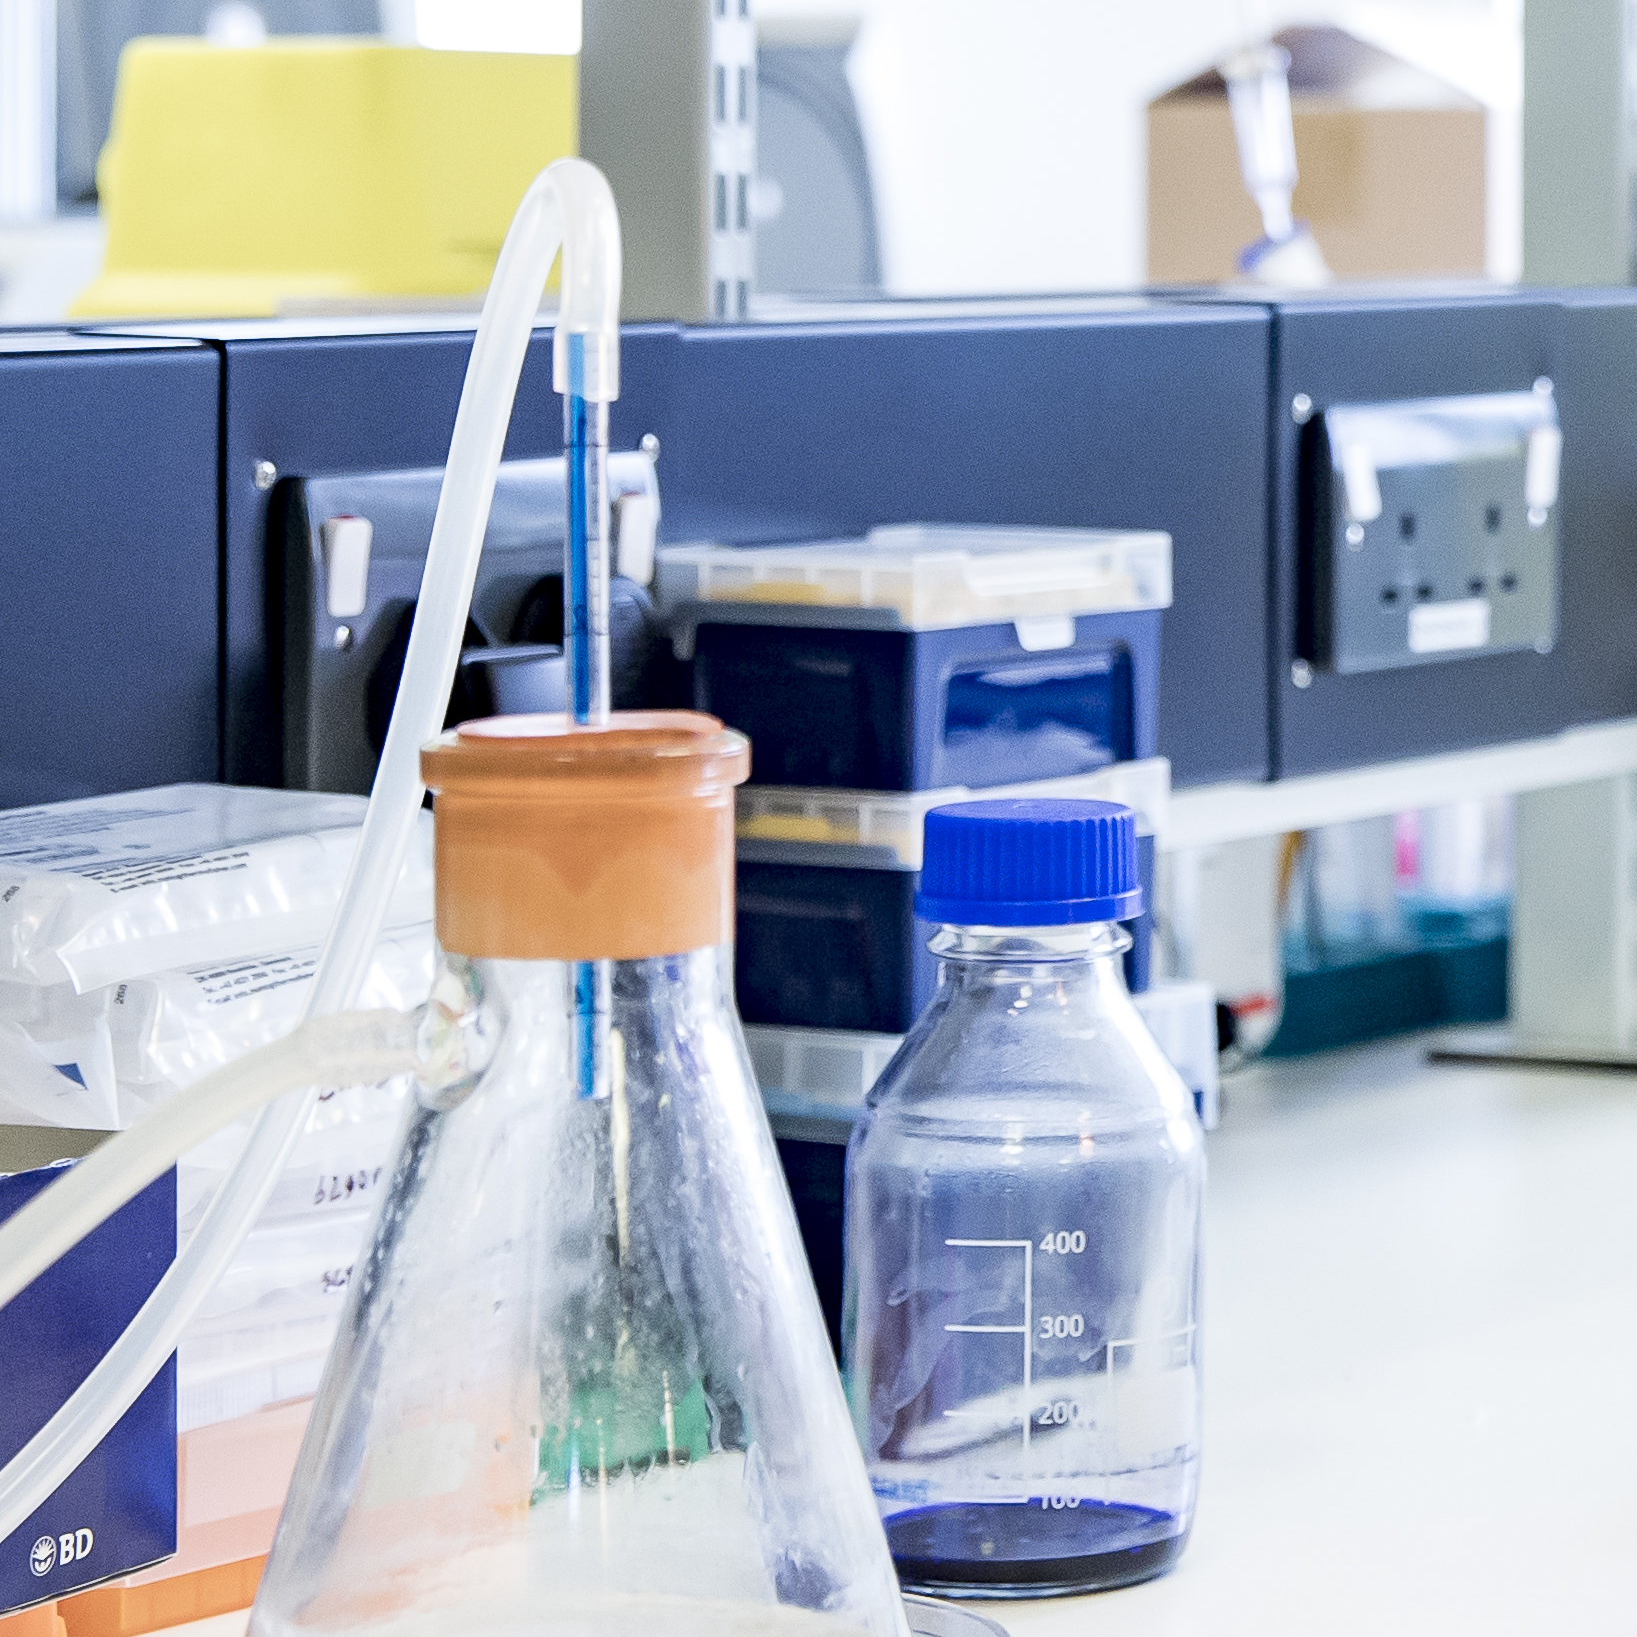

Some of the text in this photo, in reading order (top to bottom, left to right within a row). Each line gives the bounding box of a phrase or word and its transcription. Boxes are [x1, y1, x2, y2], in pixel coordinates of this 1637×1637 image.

[1039, 1230, 1086, 1254] 400
[1039, 1314, 1085, 1339] 300
[1038, 1400, 1083, 1425] 200
[58, 1528, 94, 1566] BD
